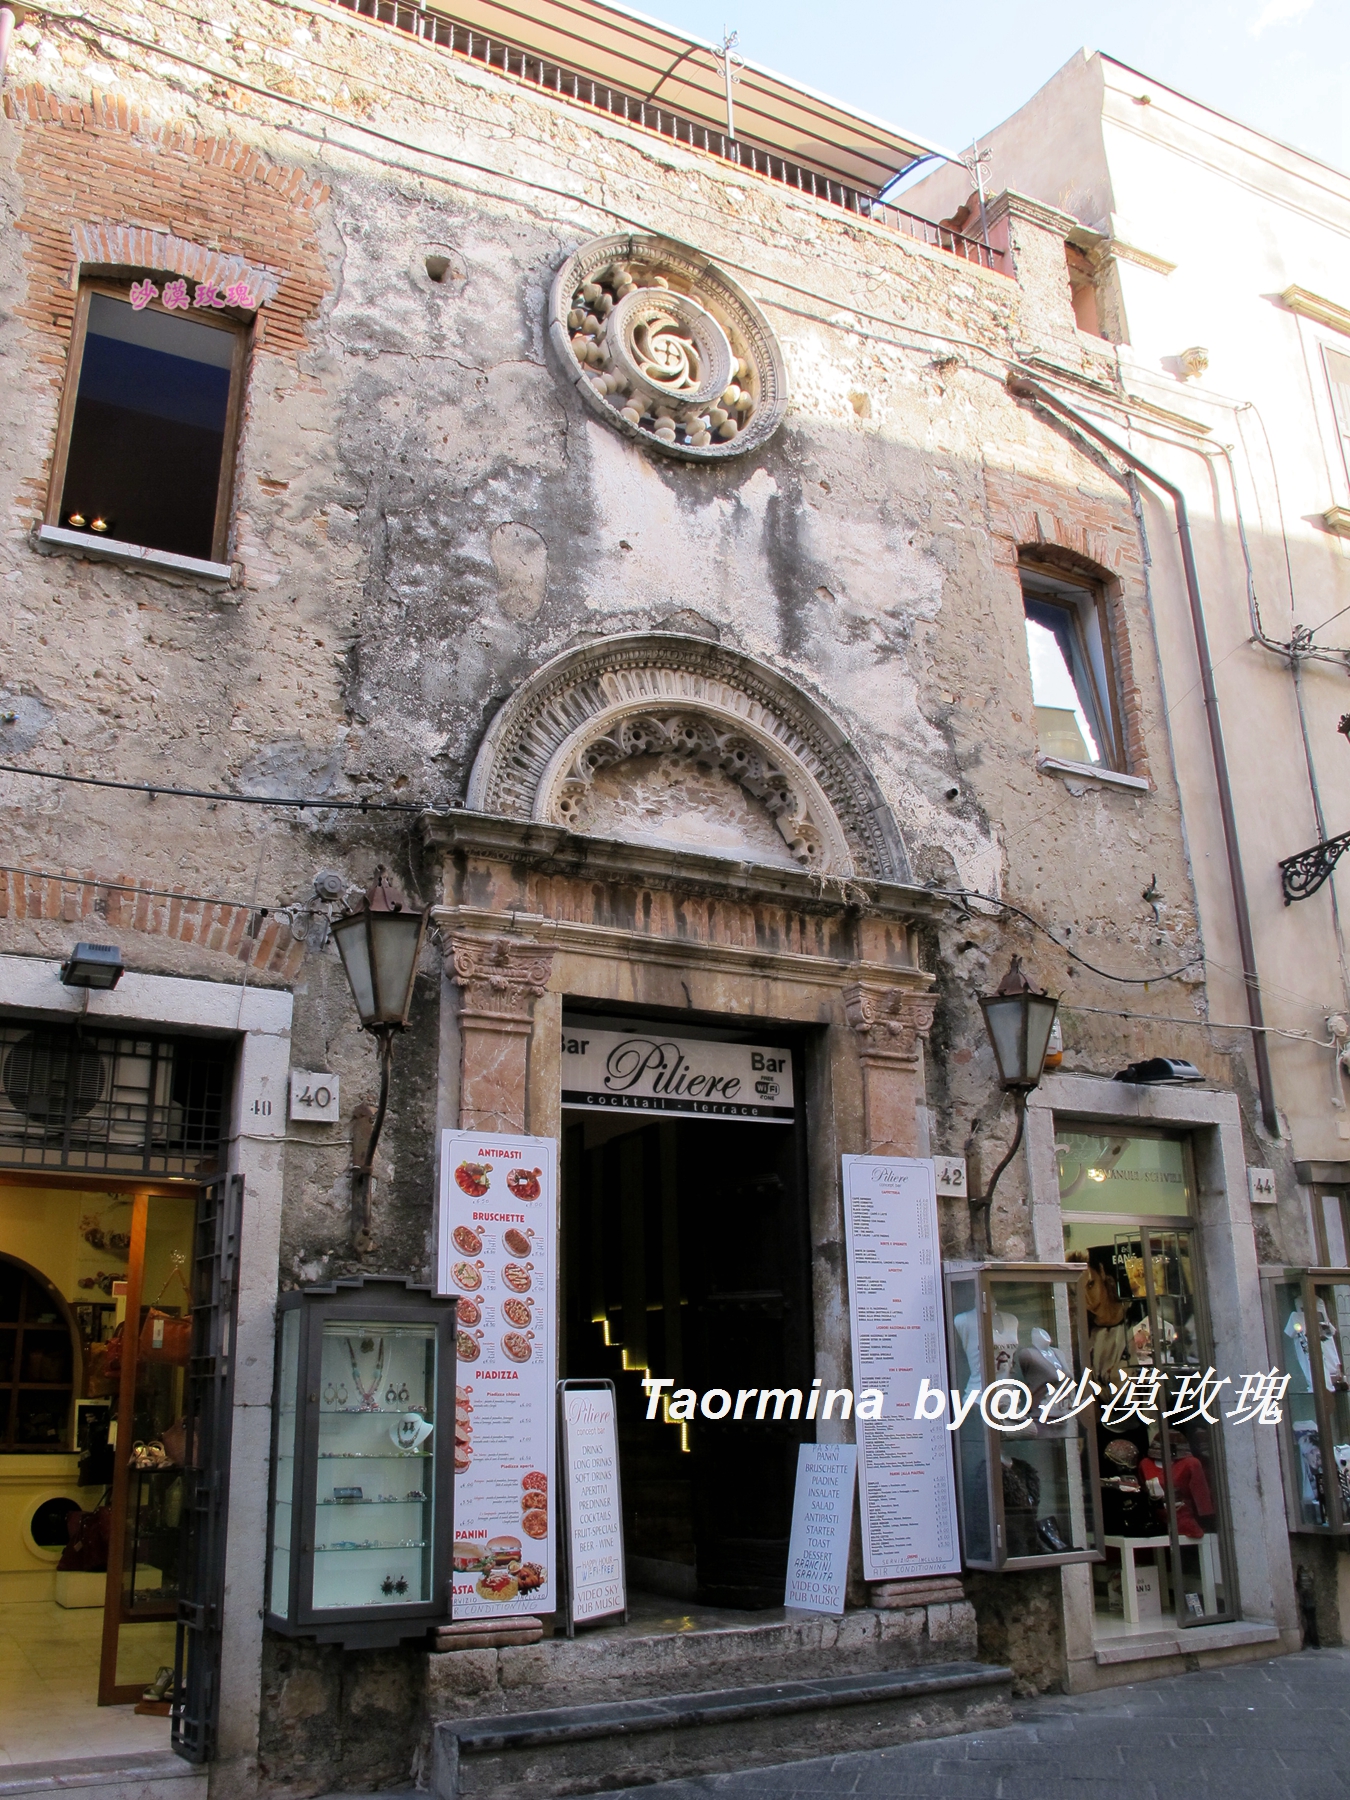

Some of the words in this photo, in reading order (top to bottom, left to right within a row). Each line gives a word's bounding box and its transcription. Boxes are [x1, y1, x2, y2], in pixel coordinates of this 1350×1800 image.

[603, 1038, 742, 1099] Piliere
[750, 1051, 786, 1073] Bar
[299, 1086, 331, 1108] 40
[586, 1094, 666, 1109] cocktail
[693, 1101, 759, 1116] terrace
[477, 1147, 523, 1161] ANTIPASTI
[870, 1166, 909, 1184] Piliere
[940, 1167, 963, 1187] 42
[1255, 1177, 1272, 1194] 44
[472, 1211, 526, 1223] BRUSCHETTE
[475, 1370, 519, 1380] PIADIZZA
[568, 1396, 611, 1426] Piliere
[576, 1427, 596, 1437] concept
[597, 1427, 606, 1436] bar
[582, 1445, 604, 1456] DRINKS
[816, 1452, 839, 1462] PANINI
[573, 1459, 590, 1471] LONG
[591, 1457, 613, 1469] DRINKS
[805, 1463, 848, 1475] BRUSCHETTE
[575, 1472, 591, 1484] SOFT
[591, 1470, 613, 1482] DRINKS
[811, 1476, 839, 1487] PIADINE
[580, 1484, 608, 1497] APERITIVI
[808, 1488, 840, 1499] INSALATE
[578, 1497, 612, 1511] PREDINNER
[811, 1500, 835, 1511] SALAD
[579, 1510, 612, 1525] COCKTAILS
[804, 1512, 839, 1525] ANTIPASTI
[455, 1529, 488, 1541] PANINI
[574, 1524, 618, 1541] FRUIT-SPECIALS
[806, 1525, 836, 1537] STARTER
[579, 1541, 594, 1553] BEER
[598, 1537, 614, 1550] WINE
[808, 1537, 831, 1548] TOAST
[597, 1556, 613, 1567] HOUR
[803, 1550, 833, 1562] DESSERT
[794, 1558, 832, 1572] ARANCINI
[873, 1567, 888, 1576] AIR
[895, 1563, 947, 1574] CONDITIONING
[795, 1568, 834, 1582] GRANITA
[453, 1585, 474, 1595] ASTA
[577, 1588, 600, 1604] VIDEO
[601, 1585, 619, 1600] SKY
[791, 1580, 820, 1593] VIDEO
[822, 1583, 841, 1596] SKY
[577, 1599, 593, 1615] PUB
[594, 1595, 620, 1611] MUSIC
[788, 1590, 807, 1602] PUB
[809, 1593, 840, 1607] MUSIC
[464, 1600, 538, 1616] CONDITIONING
